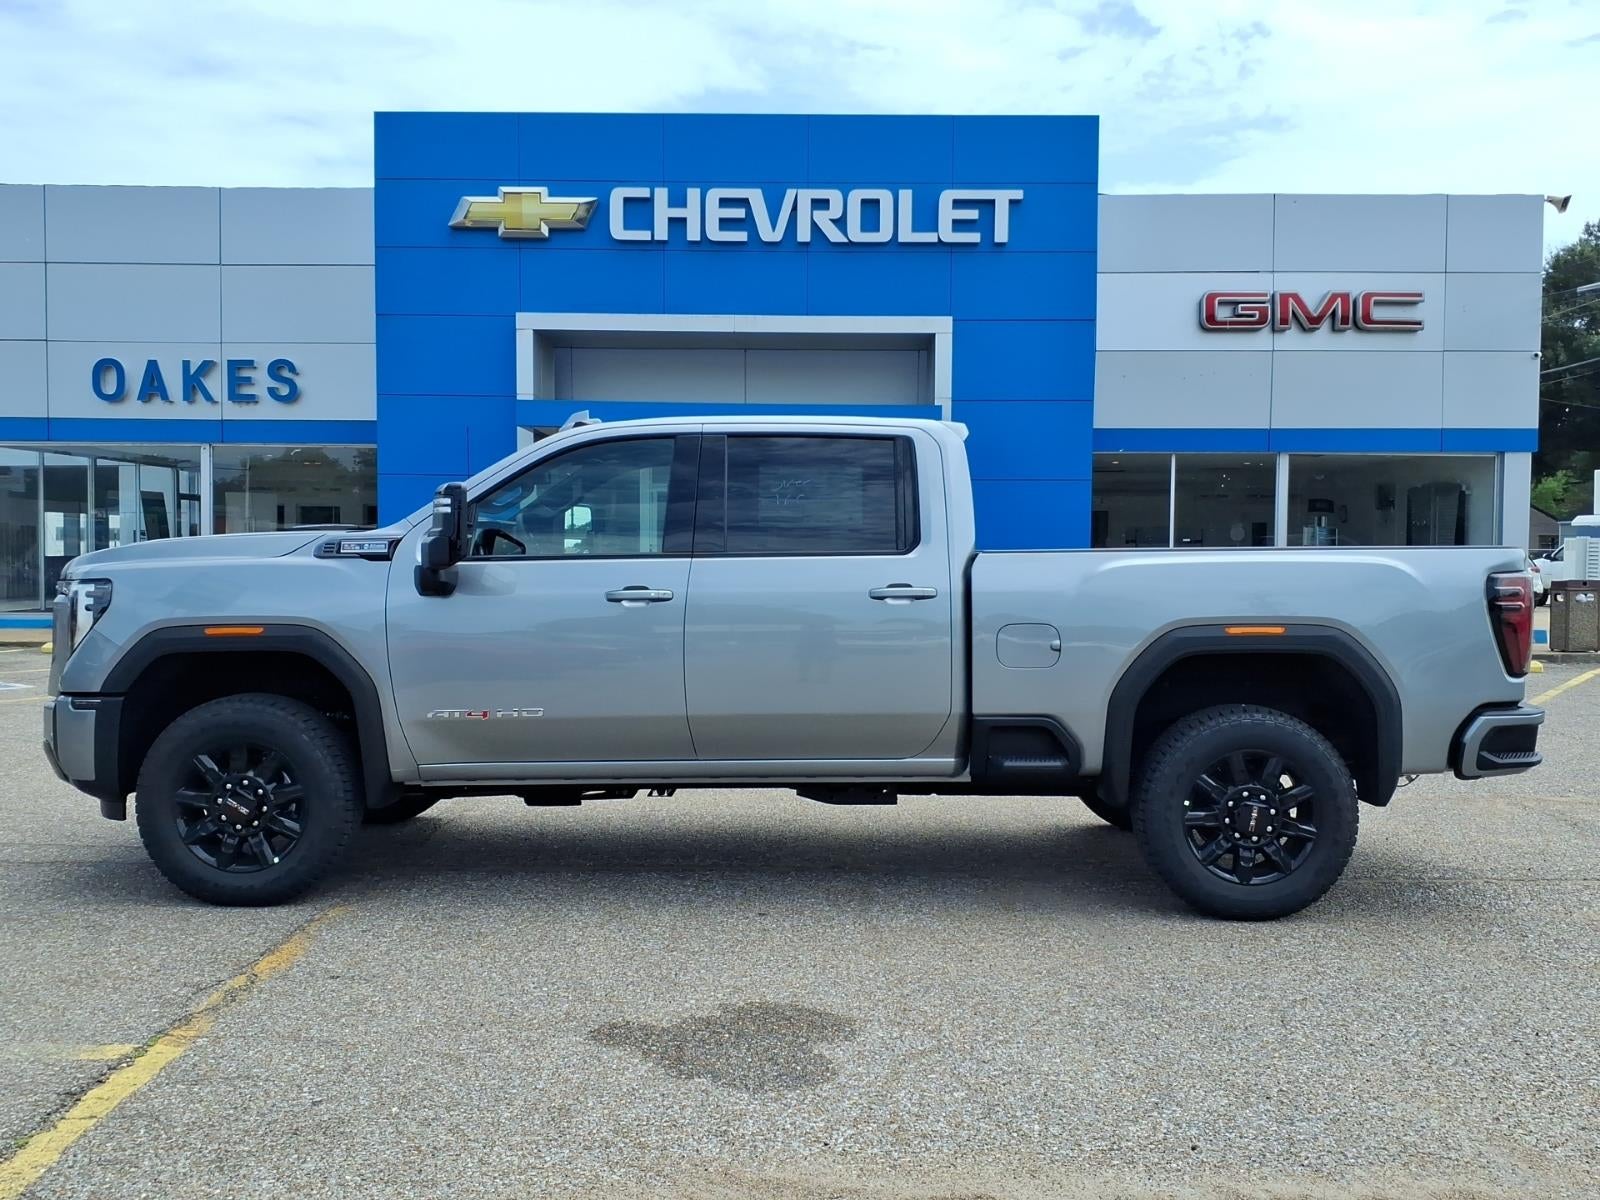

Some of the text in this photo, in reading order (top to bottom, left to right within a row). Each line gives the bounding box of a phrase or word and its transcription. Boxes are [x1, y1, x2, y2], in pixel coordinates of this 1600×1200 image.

[608, 186, 1025, 244] CHEVROLET
[1200, 290, 1424, 331] GMC
[92, 357, 300, 404] OAKES
[426, 707, 545, 720] AT4 HD
